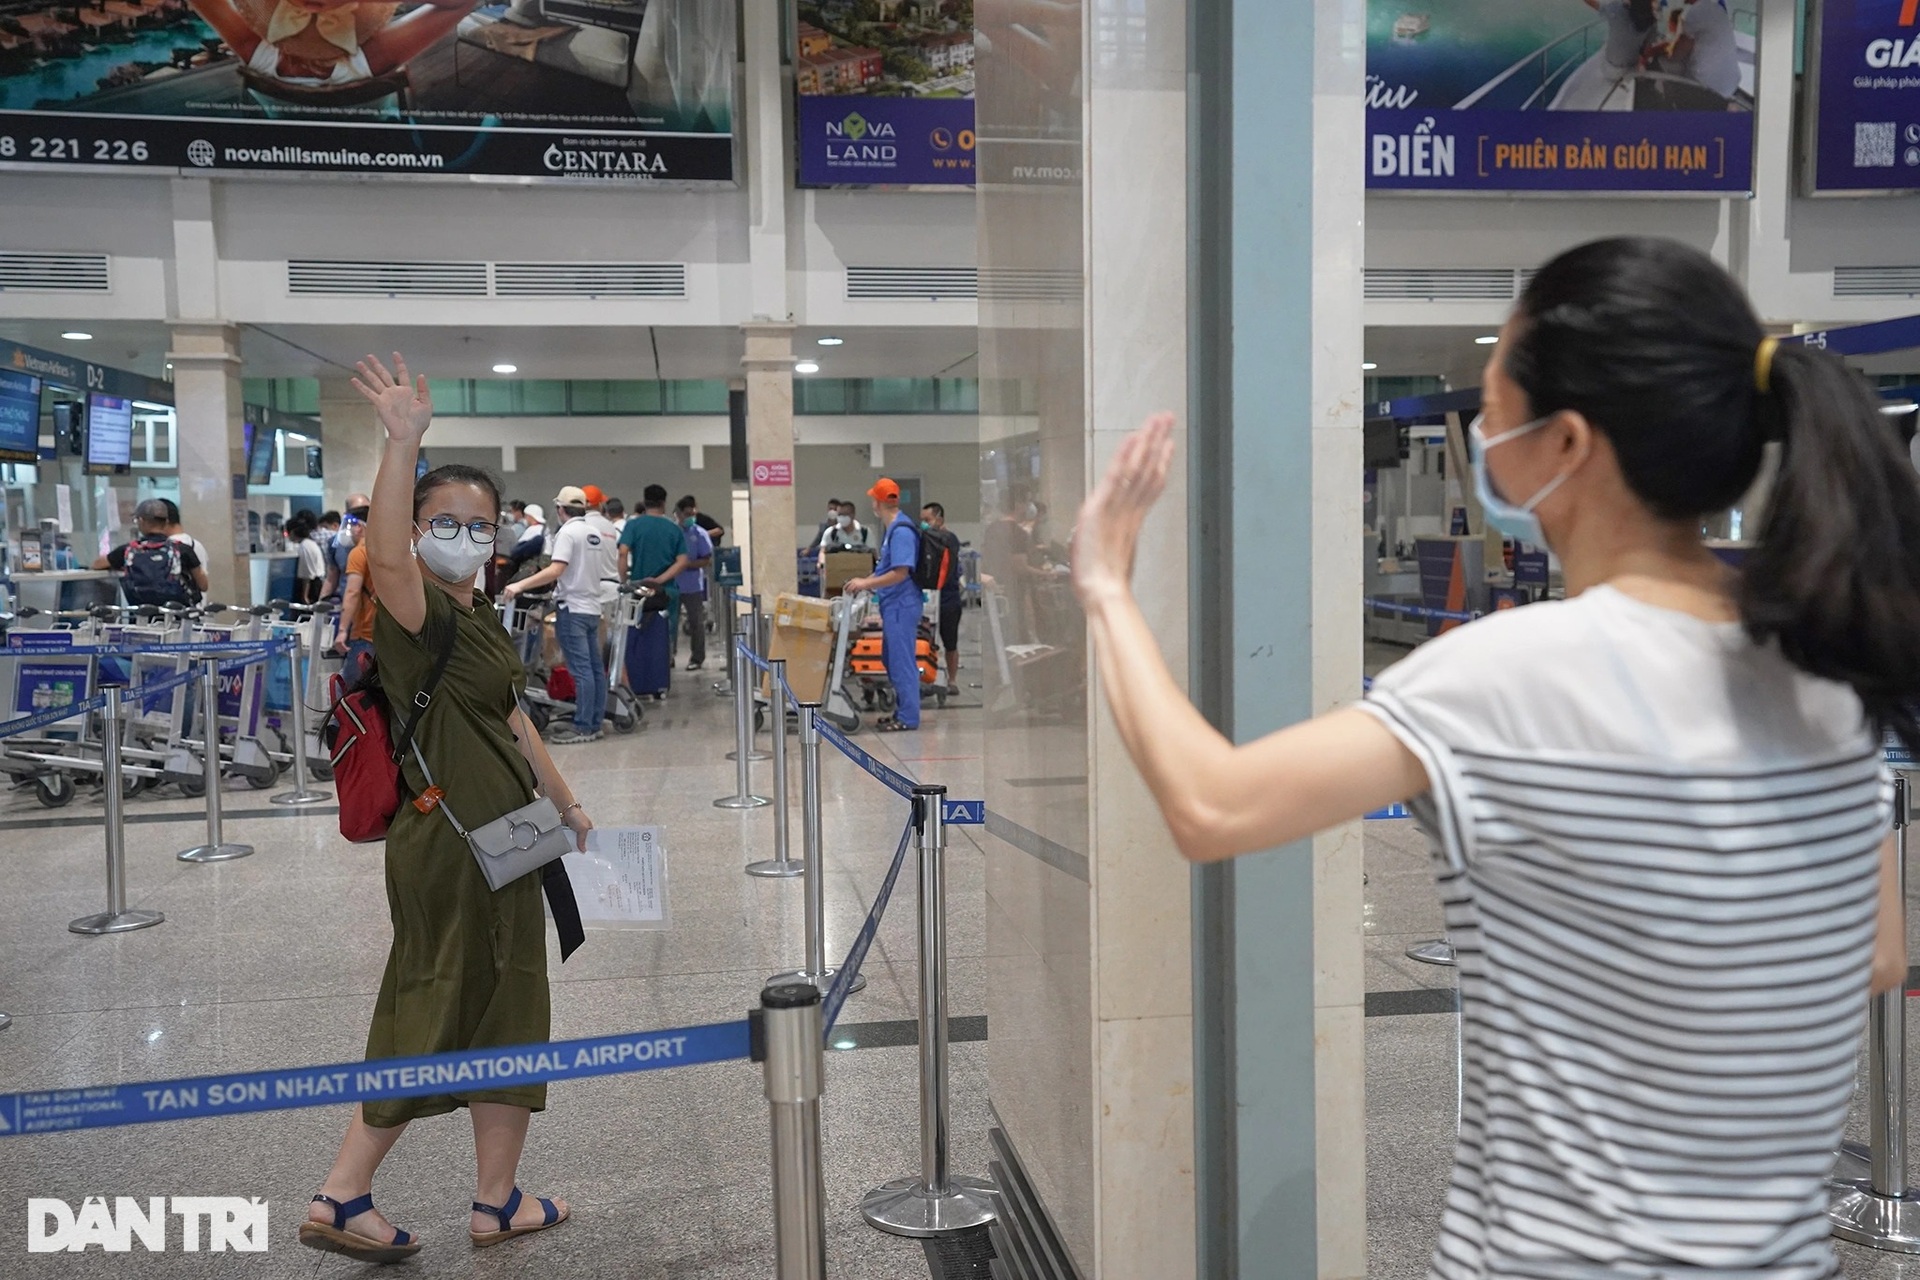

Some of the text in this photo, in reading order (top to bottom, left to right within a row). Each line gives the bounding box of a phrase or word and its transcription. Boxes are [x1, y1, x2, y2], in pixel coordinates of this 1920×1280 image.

[30, 137, 79, 158] 221
[94, 140, 149, 160] 226
[827, 146, 897, 159] LAND
[1372, 116, 1455, 176] BIỂN
[1495, 137, 1707, 175] PHIÊN BẢN GIỚI HẠN
[225, 147, 443, 167] novahillsmuine.com.vn
[543, 142, 667, 172] CENTARA
[87, 364, 104, 389] D-2
[78, 700, 91, 711] TIA
[124, 690, 135, 700] TIA
[1882, 751, 1911, 759] AITING
[942, 805, 972, 820] IA
[143, 1036, 687, 1112] TAN SON NHAT INTERNATIONAL AIRPORT
